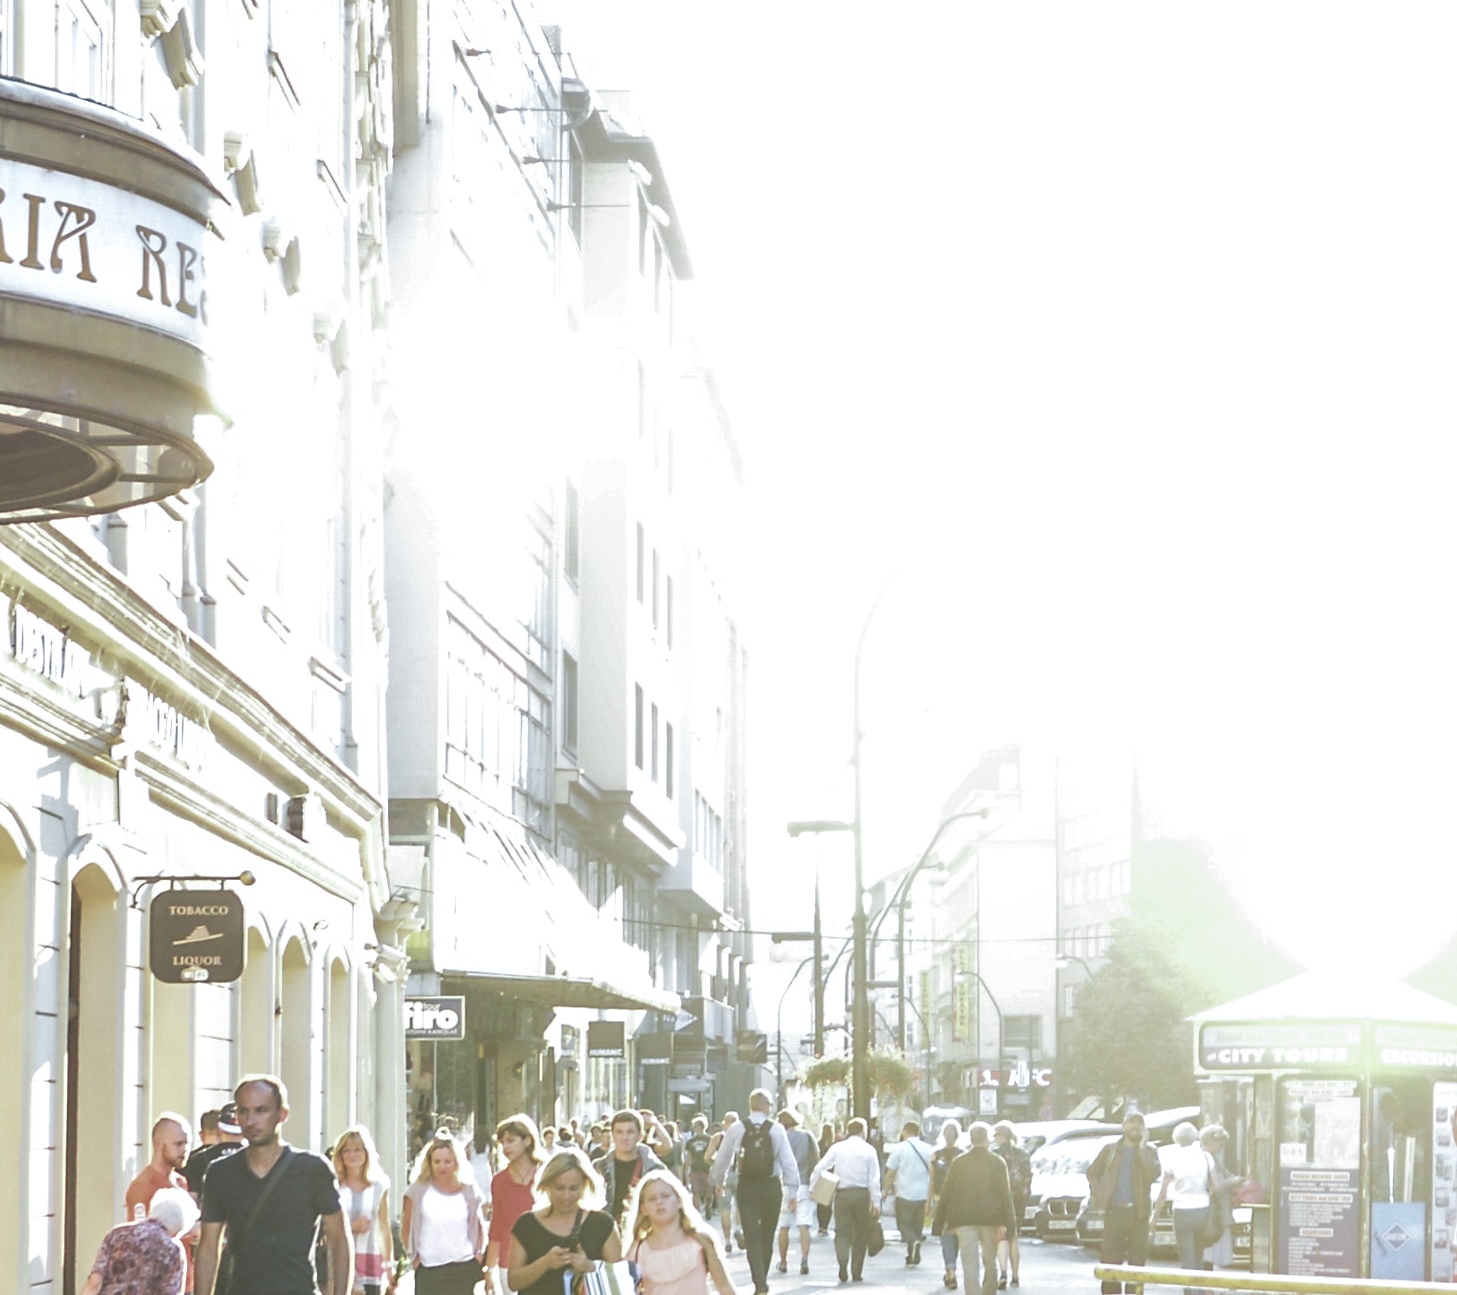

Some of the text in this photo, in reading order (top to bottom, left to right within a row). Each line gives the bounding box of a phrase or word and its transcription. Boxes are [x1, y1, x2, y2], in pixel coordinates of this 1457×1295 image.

[168, 905, 230, 916] TOBACCO
[172, 955, 223, 966] LIQUOR
[402, 1001, 459, 1030] firo
[1218, 1046, 1348, 1064] CITY TOURS
